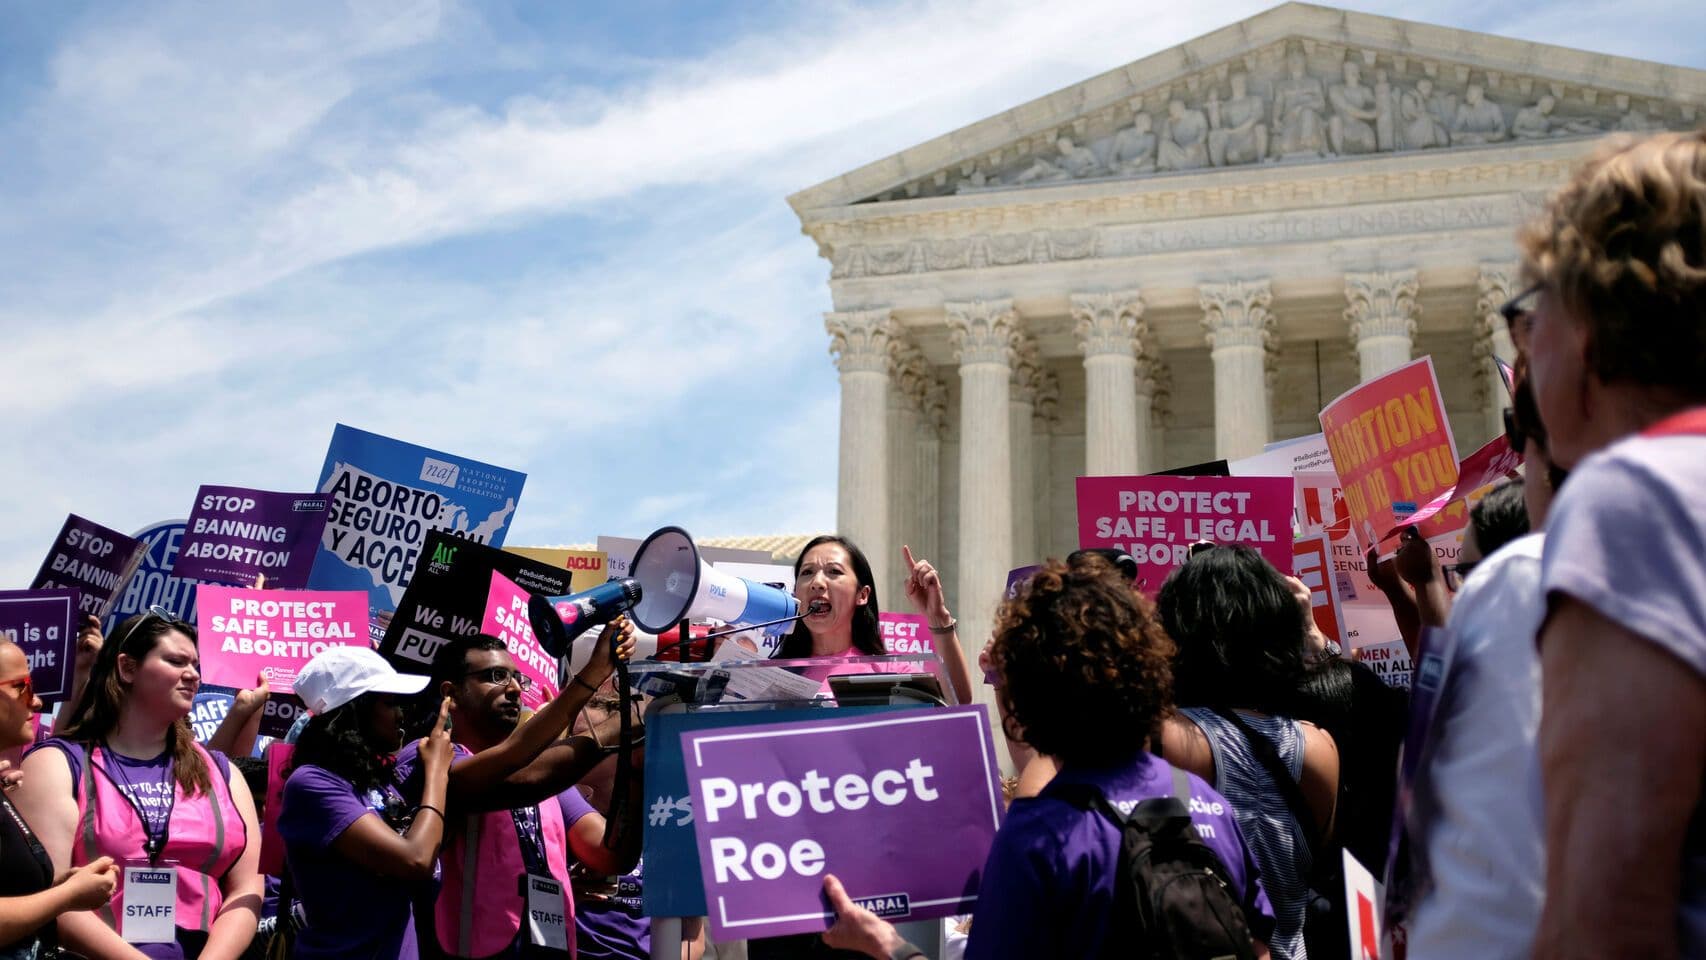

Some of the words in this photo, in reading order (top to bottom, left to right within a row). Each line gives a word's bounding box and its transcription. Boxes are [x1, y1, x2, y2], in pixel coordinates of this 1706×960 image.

[1122, 230, 1206, 254] EQUAL
[1224, 219, 1320, 244] JUSTICE
[1336, 209, 1427, 235] UNDER
[1438, 204, 1495, 227] LAW
[425, 464, 457, 486] naf
[462, 467, 507, 483] NATIONAL
[1392, 444, 1459, 500] YOU
[458, 484, 503, 500] FEDERATION
[461, 476, 506, 491] ABORTION
[201, 495, 256, 514] STOP
[302, 501, 325, 509] NARAL
[330, 471, 445, 520] ABORTO:
[1119, 491, 1251, 514] PROTECT
[193, 518, 287, 543] BANNING
[328, 499, 422, 549] SEGURO,
[1096, 517, 1175, 542] SAFE,
[1184, 518, 1276, 542] LEGAL
[65, 527, 114, 558] STOP
[332, 528, 349, 552] Y
[185, 542, 291, 567] ABORTION
[567, 557, 601, 570] ACLU
[617, 560, 626, 570] is
[51, 553, 123, 592] BANNING
[428, 567, 440, 575] ALL
[430, 561, 451, 572] ABOVE
[230, 598, 336, 619] PROTECT
[414, 604, 445, 629] We
[23, 622, 41, 642] is
[46, 626, 59, 640] a
[211, 616, 276, 640] SAFE,
[283, 621, 356, 638] LEGAL
[495, 606, 536, 647] SAFE,
[1347, 630, 1359, 638] RG
[884, 637, 934, 654] EGAL
[498, 630, 559, 692] ABORTIO
[1372, 661, 1388, 673] IN
[700, 758, 939, 823] Protect
[710, 836, 826, 884] Roe
[126, 905, 172, 917] STAFF
[855, 897, 905, 911] NARAL
[532, 910, 564, 926] STAFF
